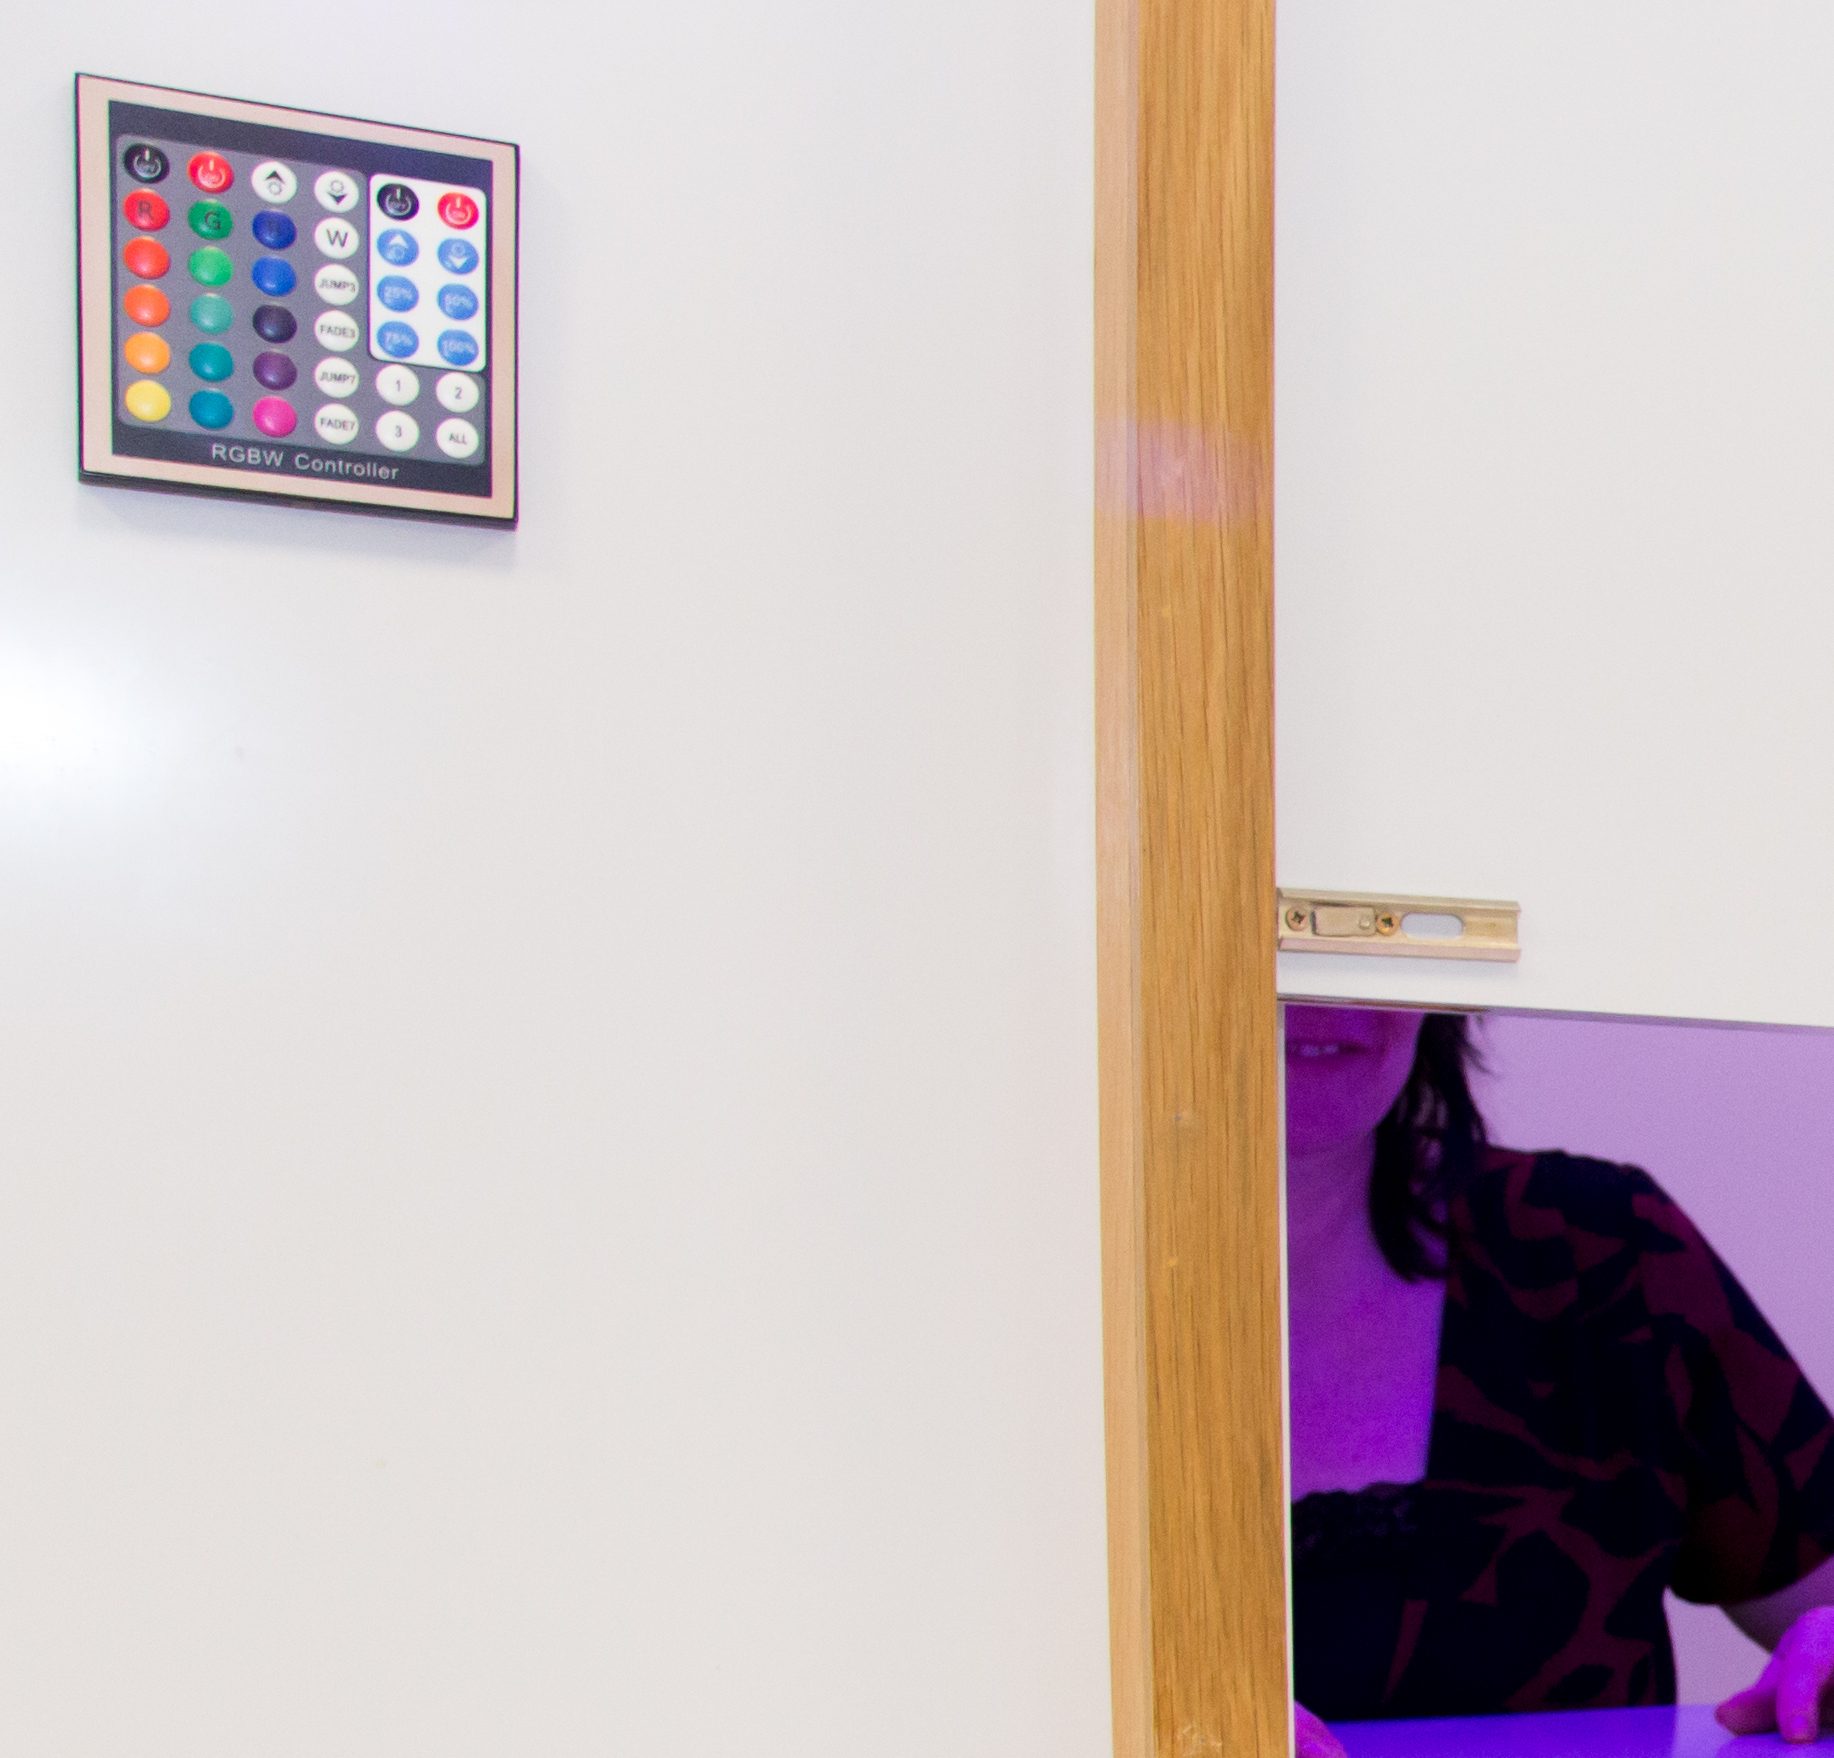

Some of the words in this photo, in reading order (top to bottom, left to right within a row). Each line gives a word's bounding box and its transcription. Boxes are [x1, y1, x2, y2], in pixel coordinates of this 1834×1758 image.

[138, 200, 153, 220] R
[204, 210, 221, 230] G
[326, 228, 349, 248] W
[319, 278, 356, 294] JUMP3
[320, 323, 356, 339] FADE3
[319, 371, 356, 387] JUMP7
[395, 379, 401, 392] 1
[454, 385, 463, 400] 2
[320, 416, 356, 431] FADE7
[449, 432, 467, 446] ALL
[211, 443, 284, 467] RGBW
[294, 452, 400, 480] Controller
